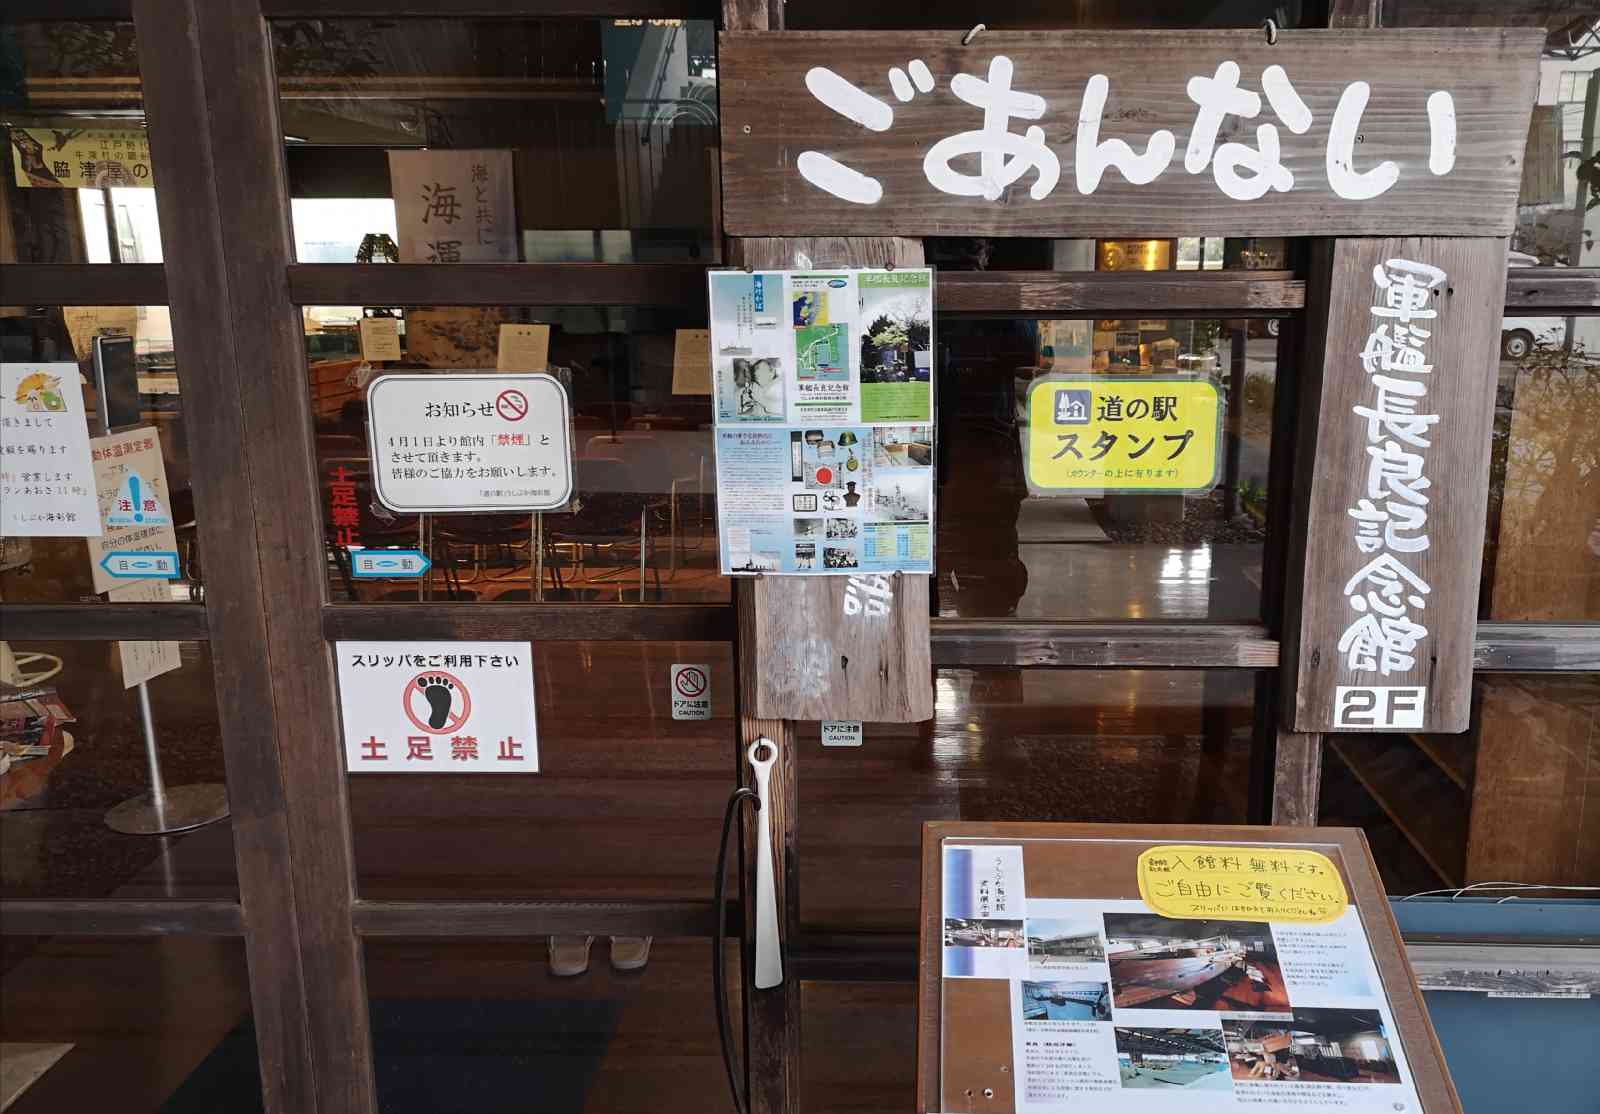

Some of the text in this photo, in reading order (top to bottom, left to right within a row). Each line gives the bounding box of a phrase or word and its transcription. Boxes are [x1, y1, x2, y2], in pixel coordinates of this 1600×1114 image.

[797, 55, 1457, 204] ごあんない
[425, 402, 495, 418] お知らせ
[1097, 396, 1179, 422] 道の駅
[1052, 429, 1195, 461] スタンプ
[391, 451, 481, 464] させて頂きます。
[391, 465, 557, 480] 皆様のご協力をお願いします。
[118, 499, 158, 512] 注意
[352, 654, 520, 668] スリッパをご利用下さい
[1339, 688, 1419, 726] 2F
[361, 735, 525, 762] 土足禁止
